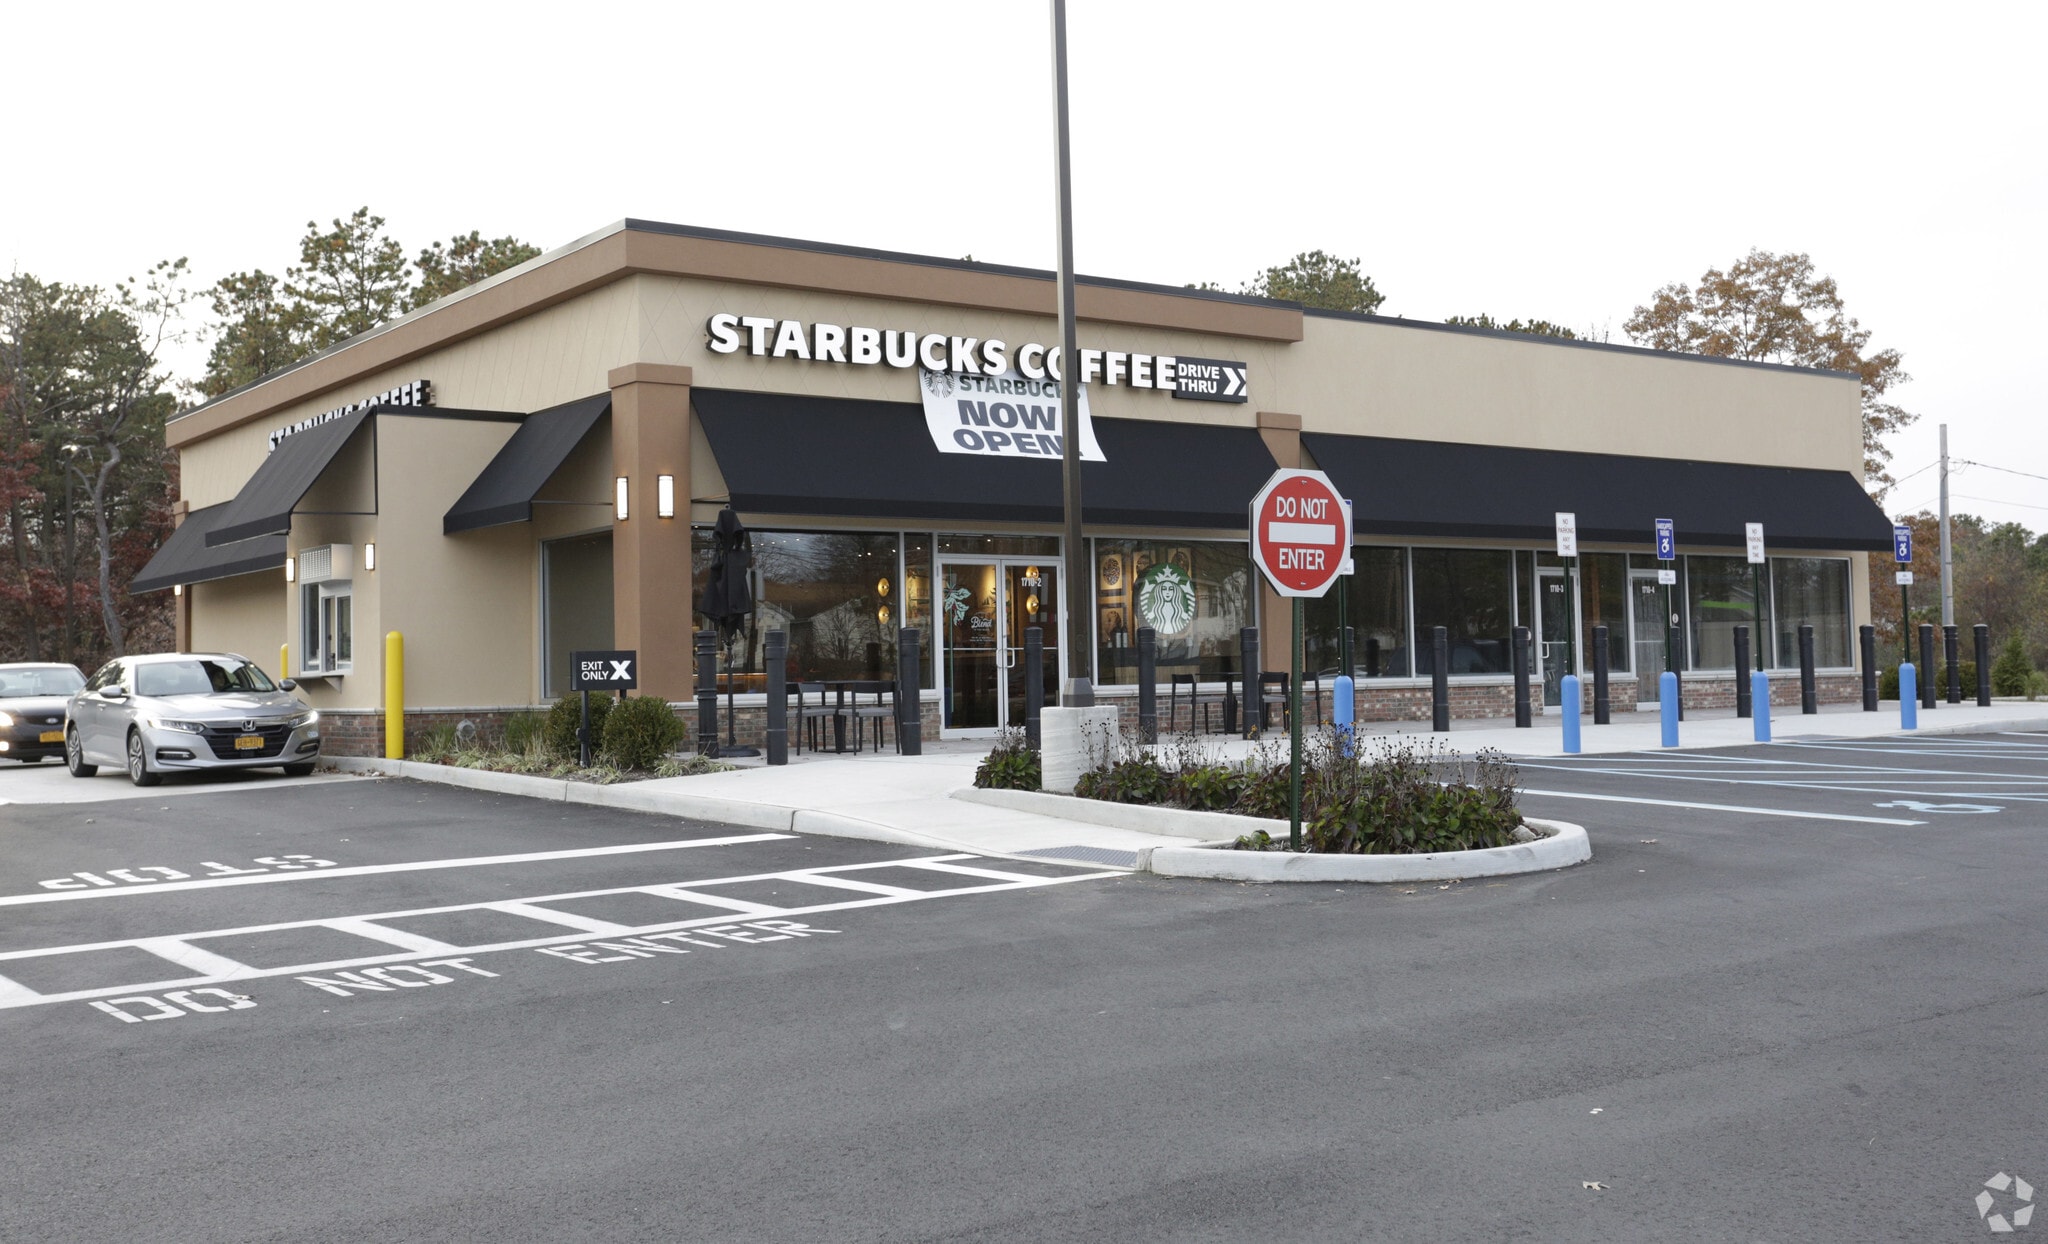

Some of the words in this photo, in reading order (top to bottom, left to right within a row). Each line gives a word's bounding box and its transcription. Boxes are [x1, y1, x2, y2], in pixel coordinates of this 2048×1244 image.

[707, 313, 1008, 376] STARBUCKS
[1178, 363, 1220, 380] DRIVE
[960, 375, 1081, 399] STARBUC
[1178, 378, 1217, 394] THRU
[957, 399, 1056, 431] NOW
[1276, 496, 1296, 517] DO
[1301, 498, 1328, 519] NOT
[1279, 548, 1325, 570] ENTER
[1021, 577, 1042, 587] 1710-2
[581, 661, 604, 671] EXIT
[581, 670, 609, 681] ONLY
[88, 988, 257, 1023] DO
[294, 958, 501, 997] NOT
[535, 920, 843, 964] ENTER
